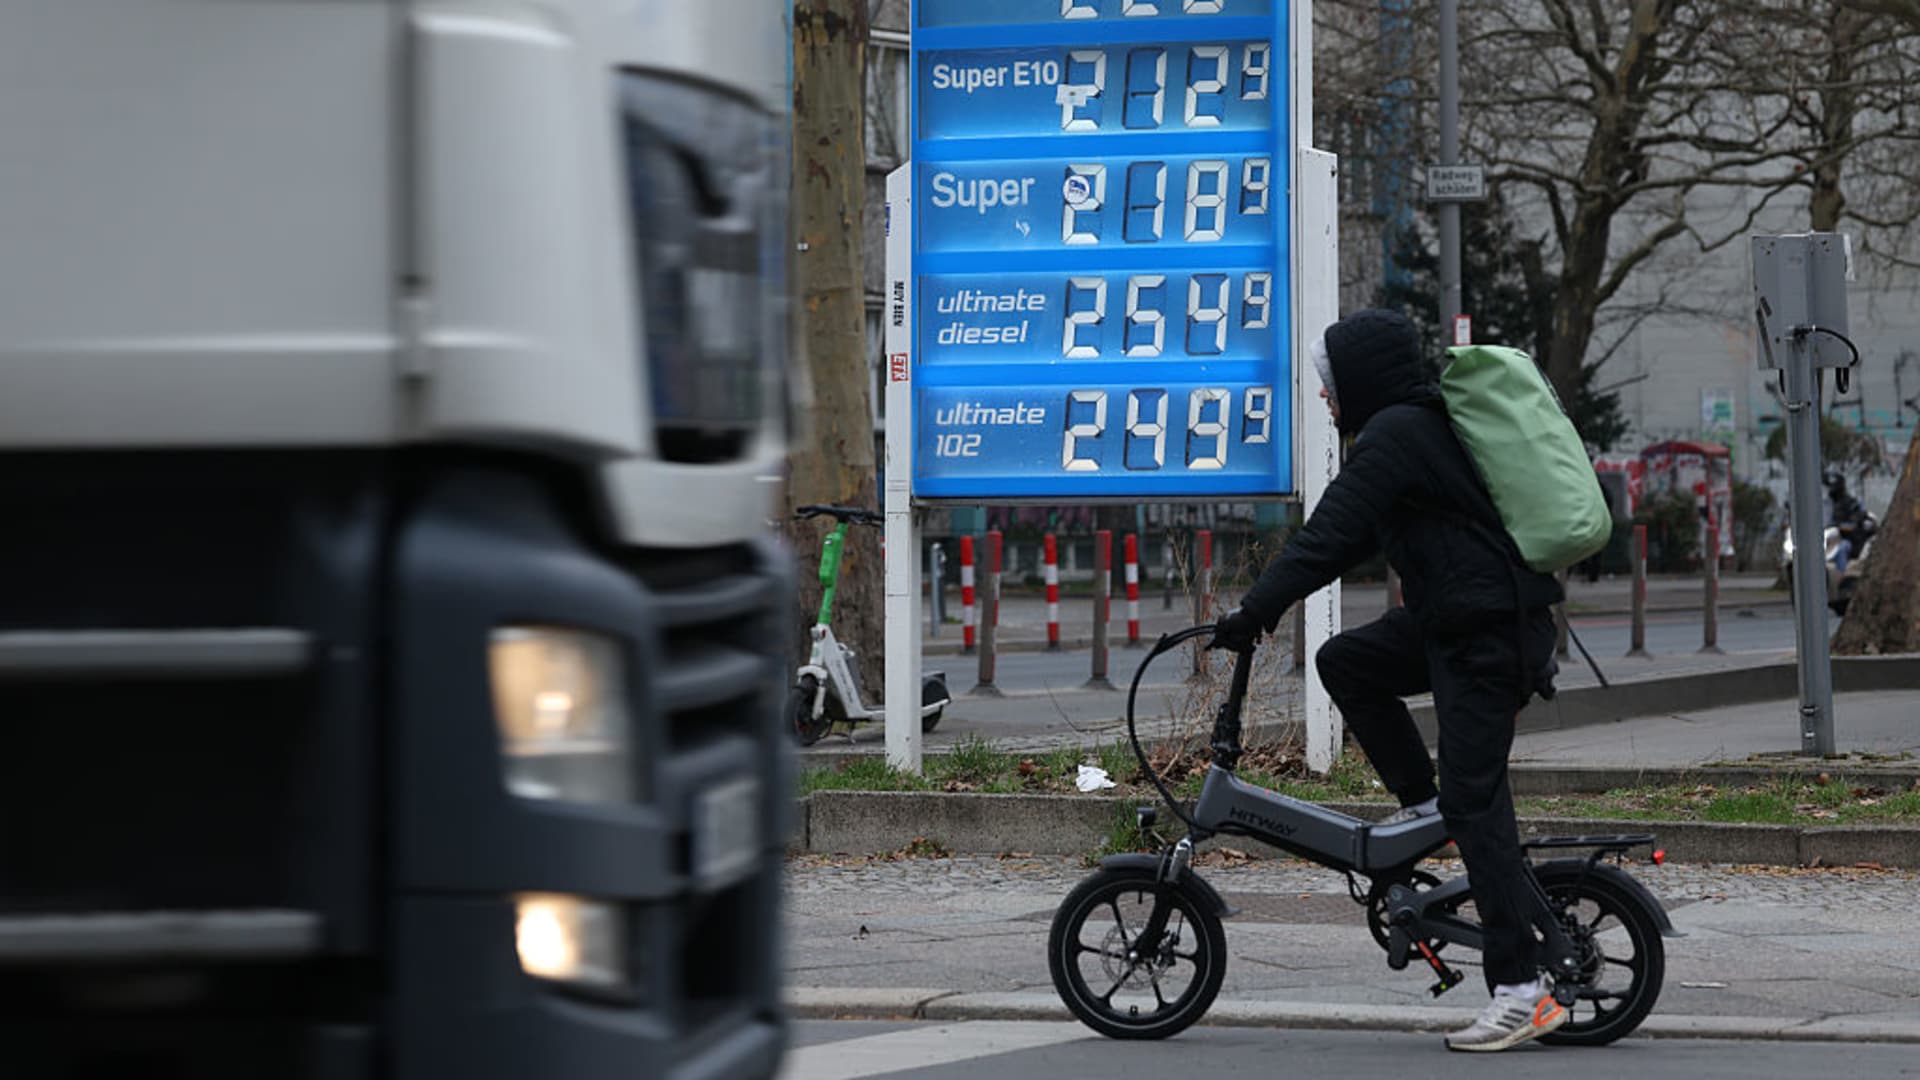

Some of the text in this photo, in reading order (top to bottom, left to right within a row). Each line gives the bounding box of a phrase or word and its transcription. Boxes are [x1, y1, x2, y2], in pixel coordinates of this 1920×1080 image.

[932, 63, 1007, 93] Super
[1014, 60, 1059, 86] E10
[932, 173, 1035, 214] Super
[937, 289, 1045, 313] ultimate
[937, 321, 1028, 345] diesel
[935, 402, 1045, 425] ultimate
[935, 434, 981, 457] 102
[1230, 806, 1297, 836] HITWAY
